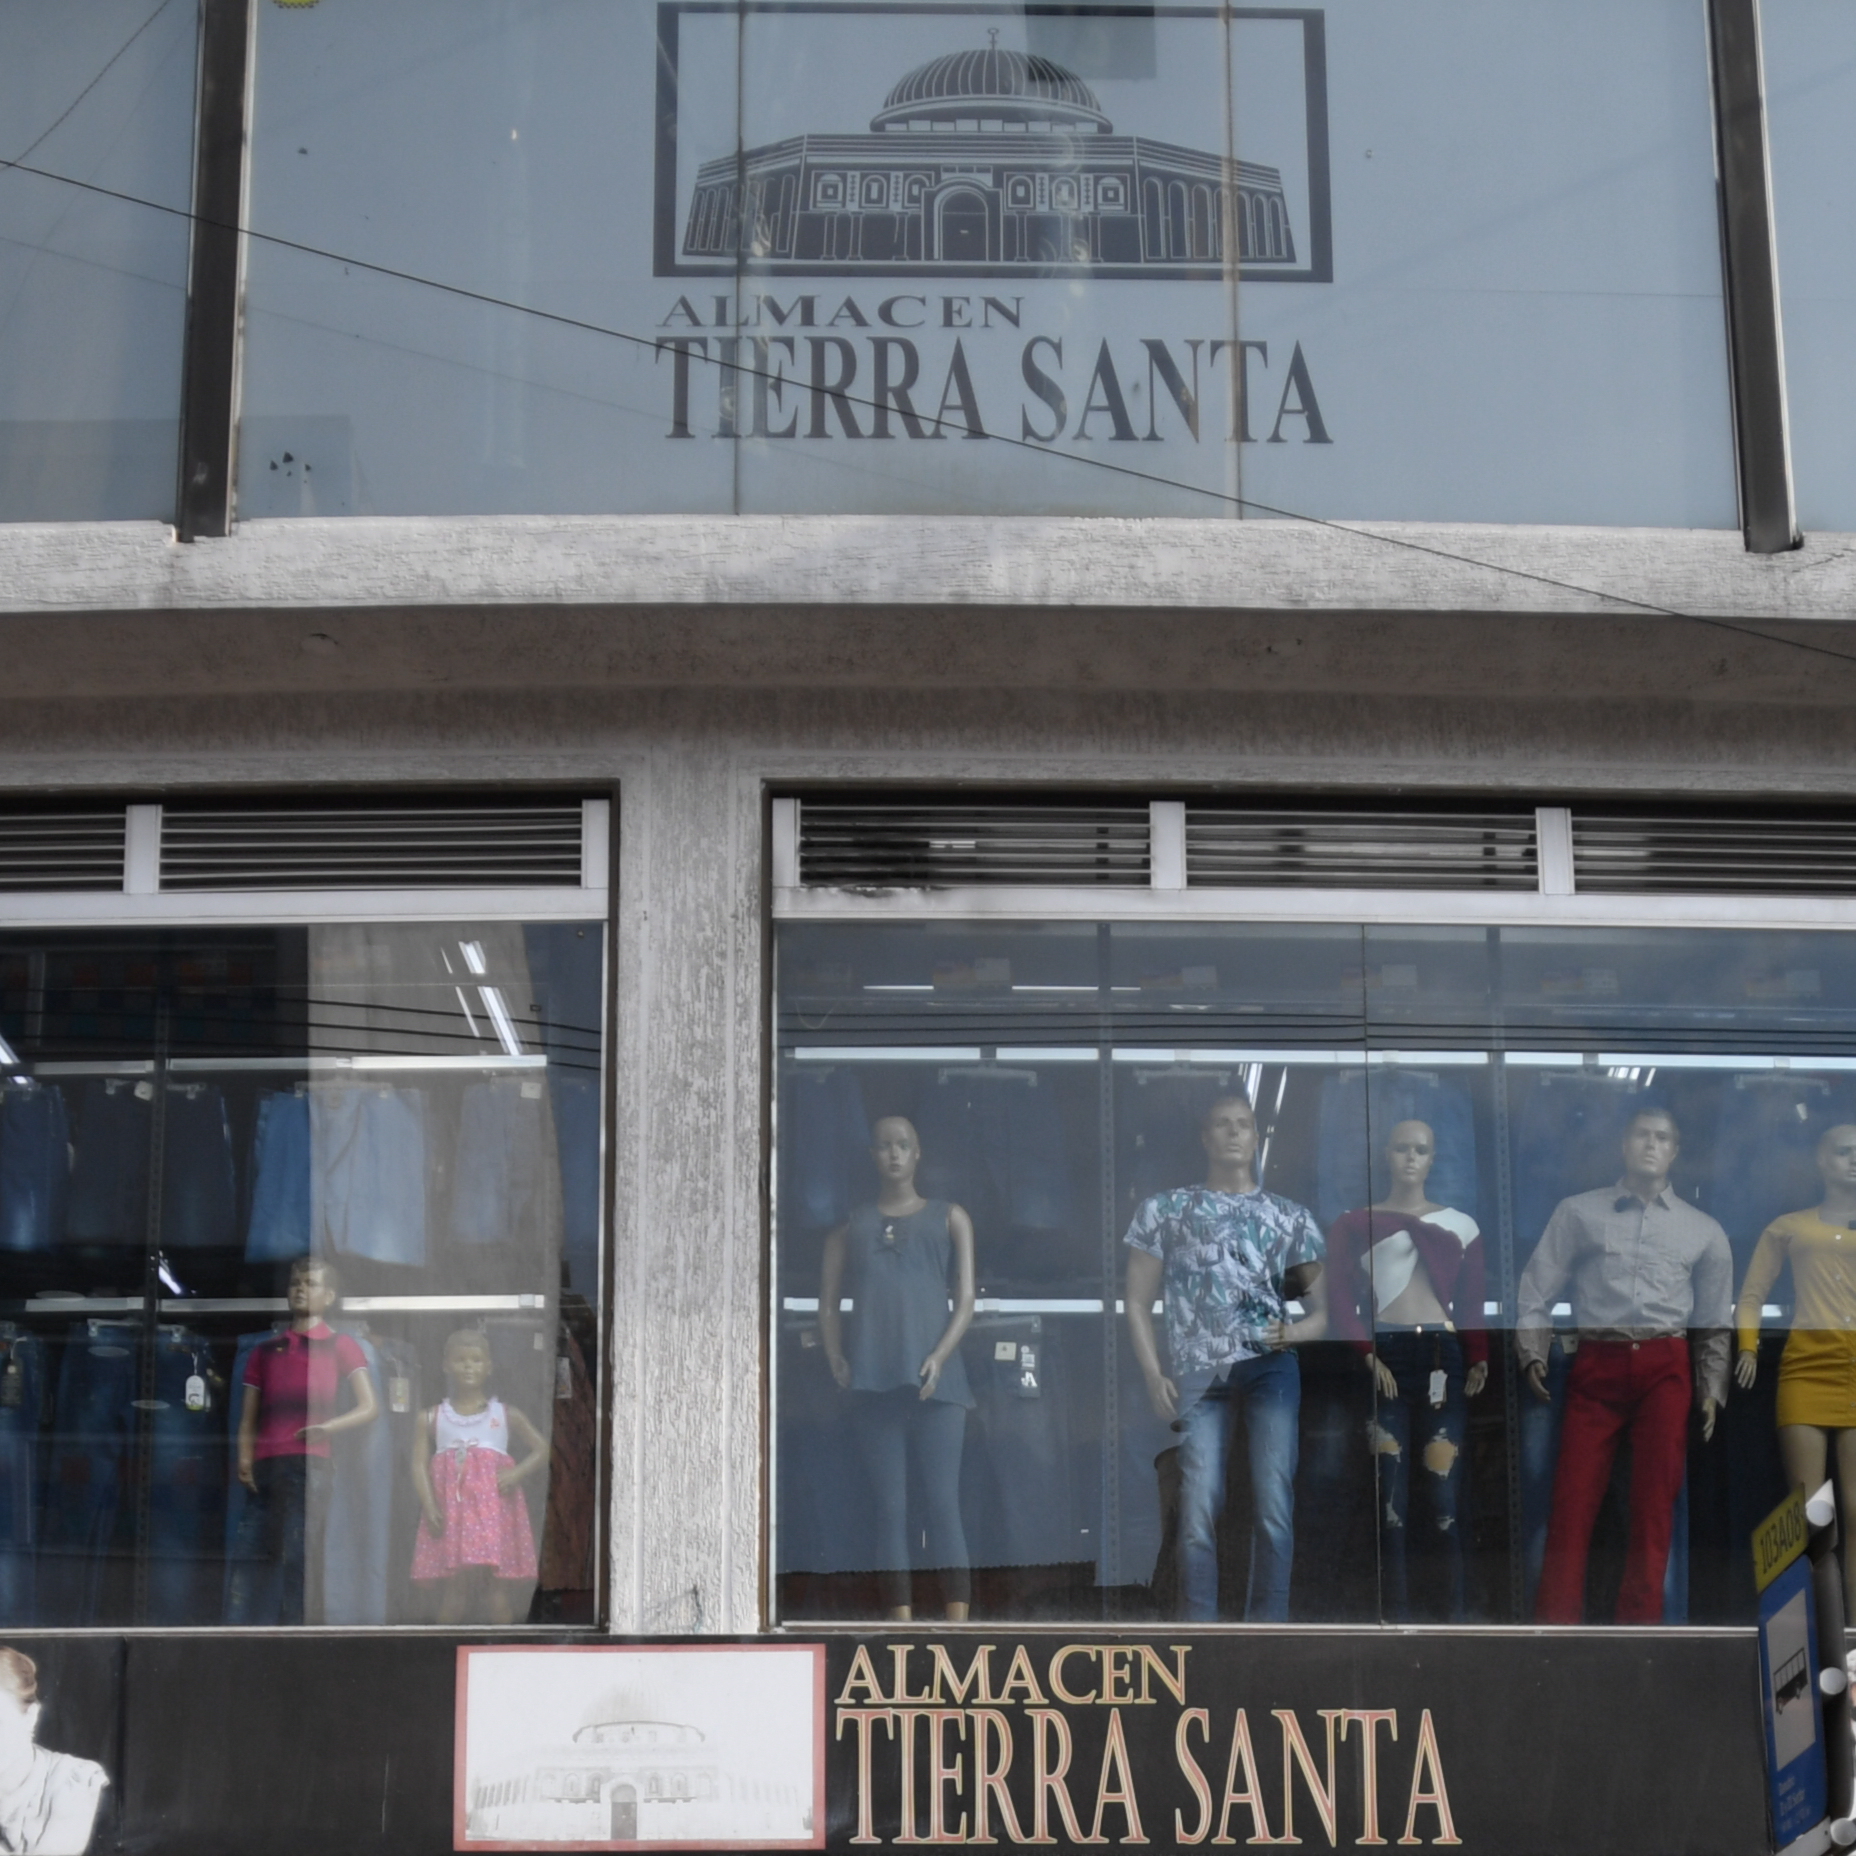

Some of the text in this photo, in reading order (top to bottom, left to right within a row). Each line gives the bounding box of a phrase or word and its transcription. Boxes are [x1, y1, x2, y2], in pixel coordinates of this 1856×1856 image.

[655, 295, 1024, 328] ALMACEN
[655, 334, 1334, 444] TIERRA SANTA
[1759, 1501, 1802, 1575] 103A08
[833, 1643, 1192, 1706] ALMACEN
[834, 1706, 1463, 1848] TIERRA SANTA
